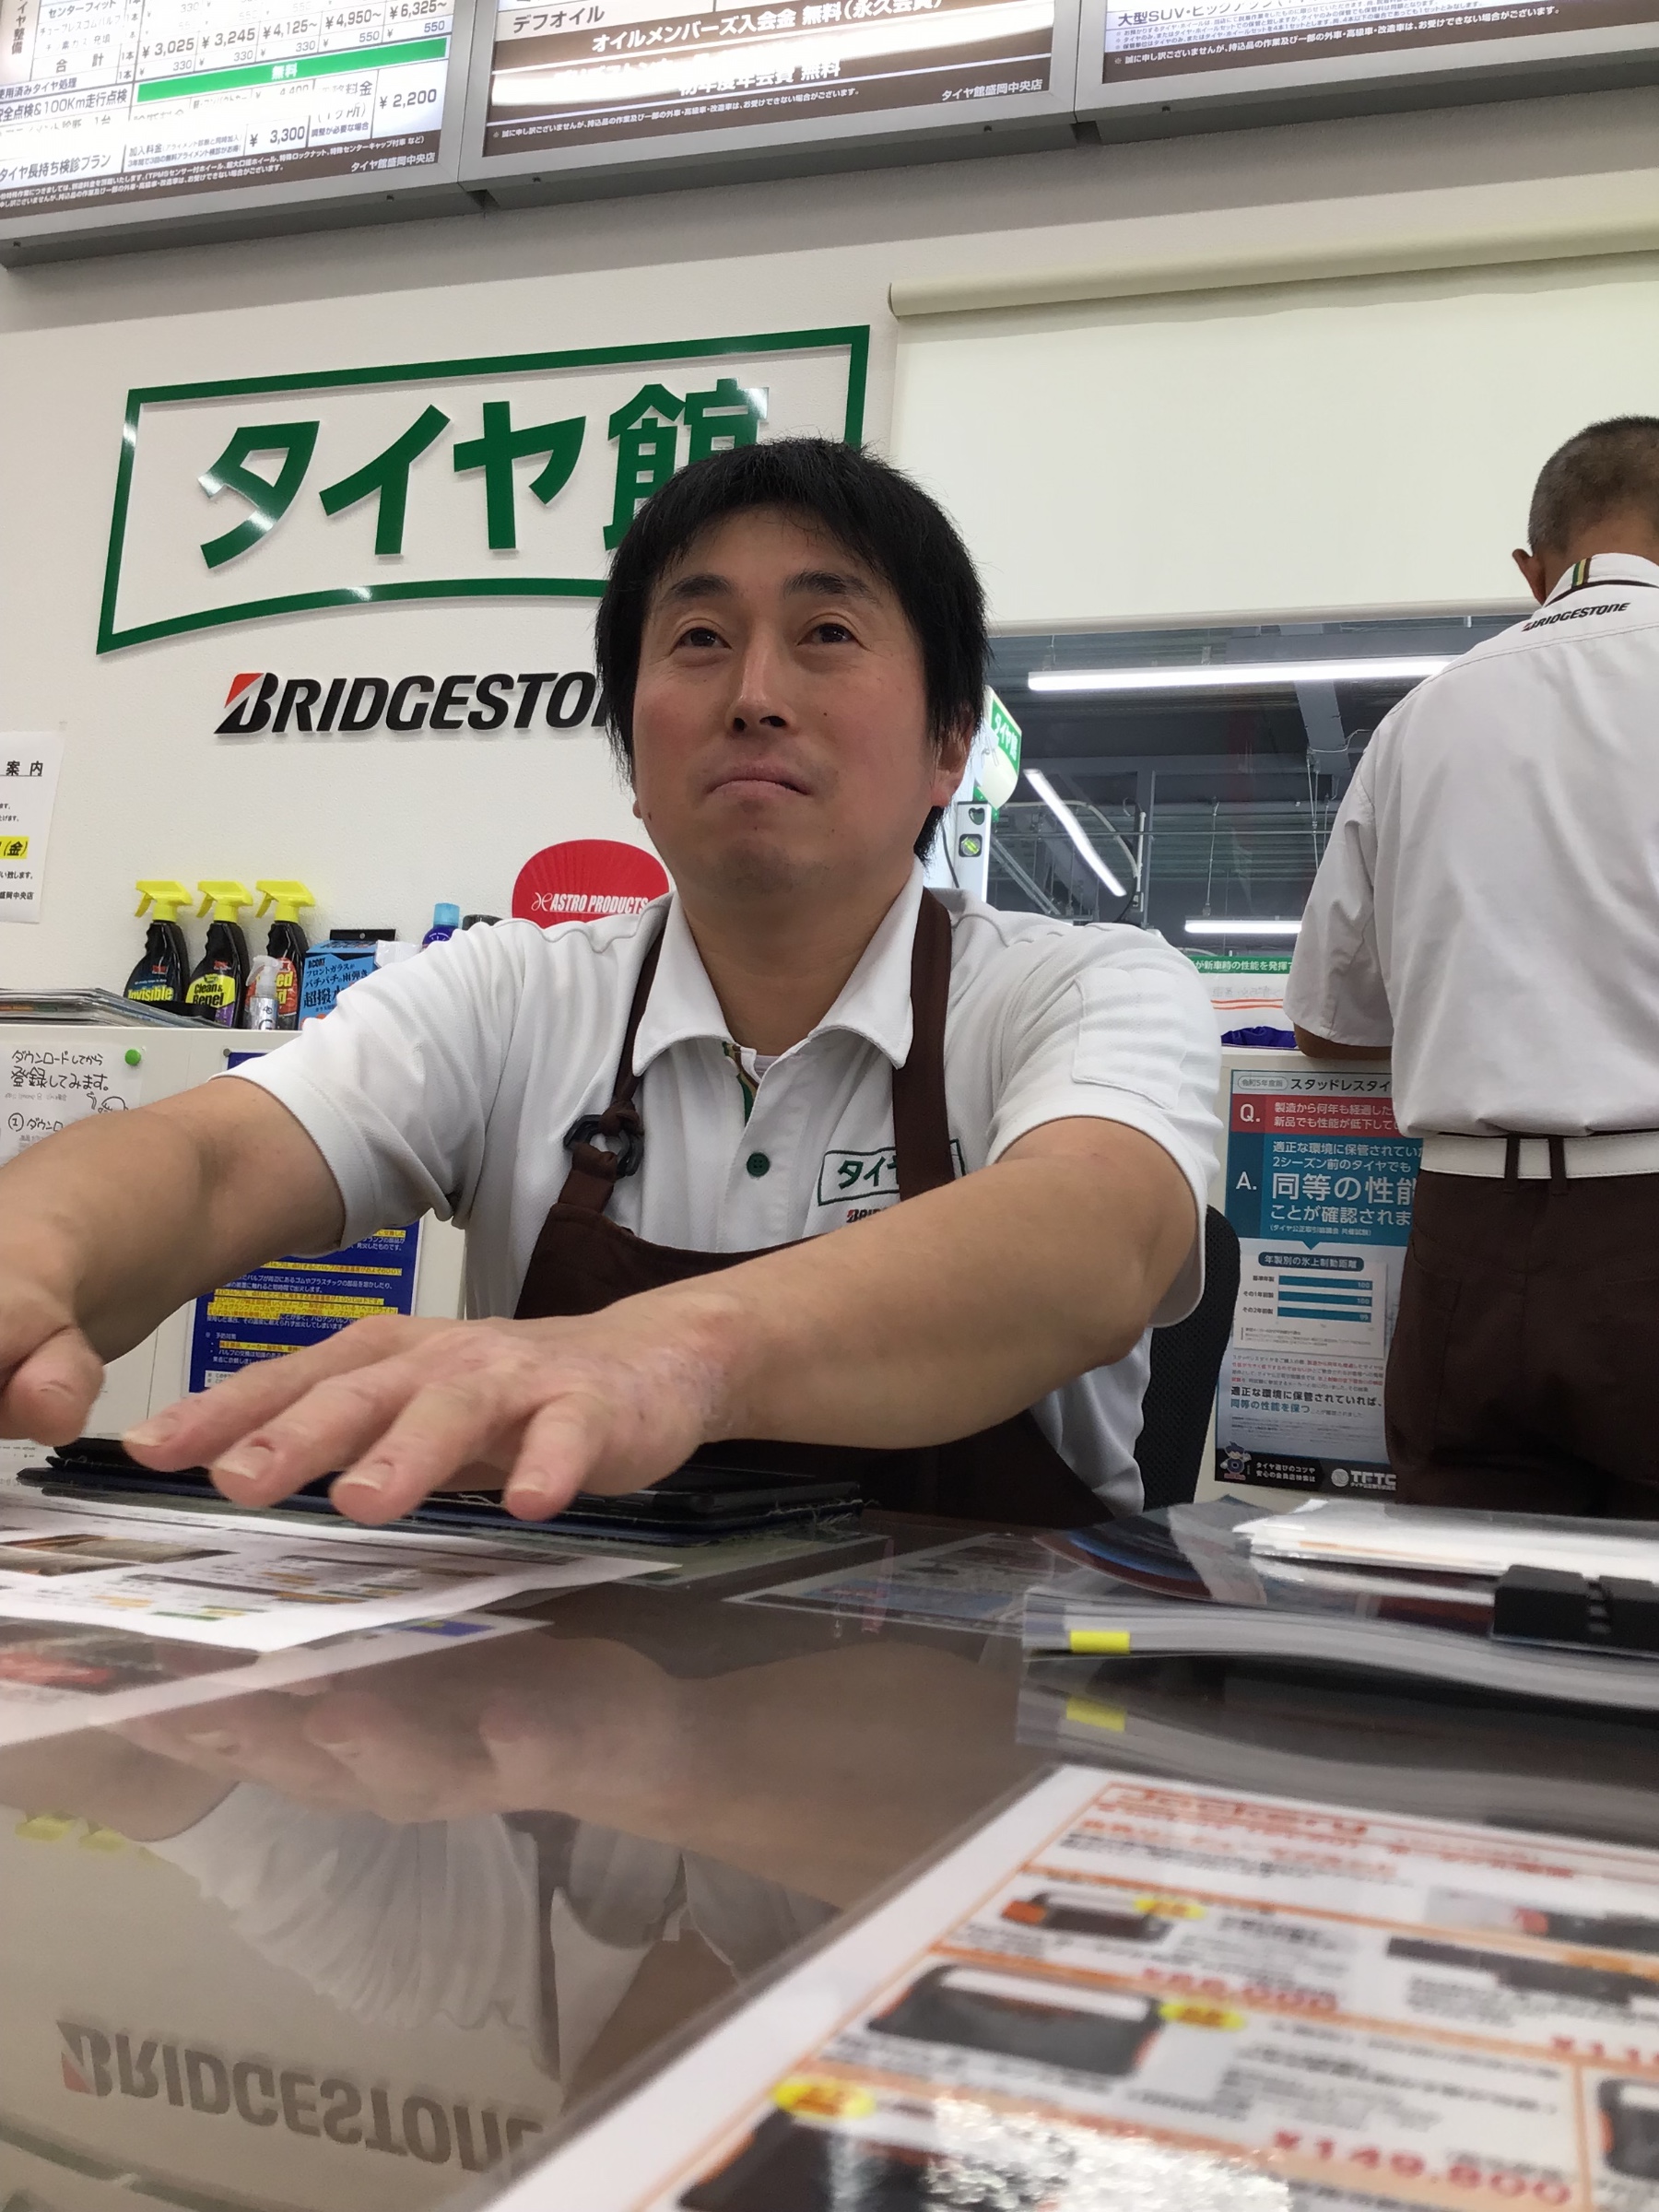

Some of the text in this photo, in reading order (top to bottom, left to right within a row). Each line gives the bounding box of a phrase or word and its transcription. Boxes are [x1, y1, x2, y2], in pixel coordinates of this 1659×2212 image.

[12, 0, 29, 55] イヤ整備
[424, 20, 445, 33] 550
[512, 6, 606, 34] デフオイル
[591, 8, 797, 53] オイルメンバーズ入会金
[271, 62, 298, 80] 無料
[941, 78, 1043, 101] タイヤ館盛岡中央店
[0, 88, 128, 123] 全点検&100Km走行点検
[270, 126, 305, 146] 3,300
[350, 151, 436, 172] タイヤ館盛岡中央店
[1521, 602, 1631, 632] BRIDGESTONE
[0, 841, 29, 857] (金)
[550, 893, 649, 915] ASTRO PRODUCTS
[1195, 960, 1292, 971] が新車時の性能を発揮
[127, 984, 174, 1002] Invisible
[11, 1050, 104, 1066] ダウンロードしてから
[10, 1065, 109, 1091] 登録してみます。
[1240, 1102, 1261, 1124] Q.
[1273, 1140, 1423, 1158] 適正な環境に保管されてい
[1272, 1157, 1412, 1173] 2シーズン前のタイヤでも
[1235, 1171, 1257, 1192] A.
[1230, 1386, 1382, 1407] 適正な環境に保管されていれば、
